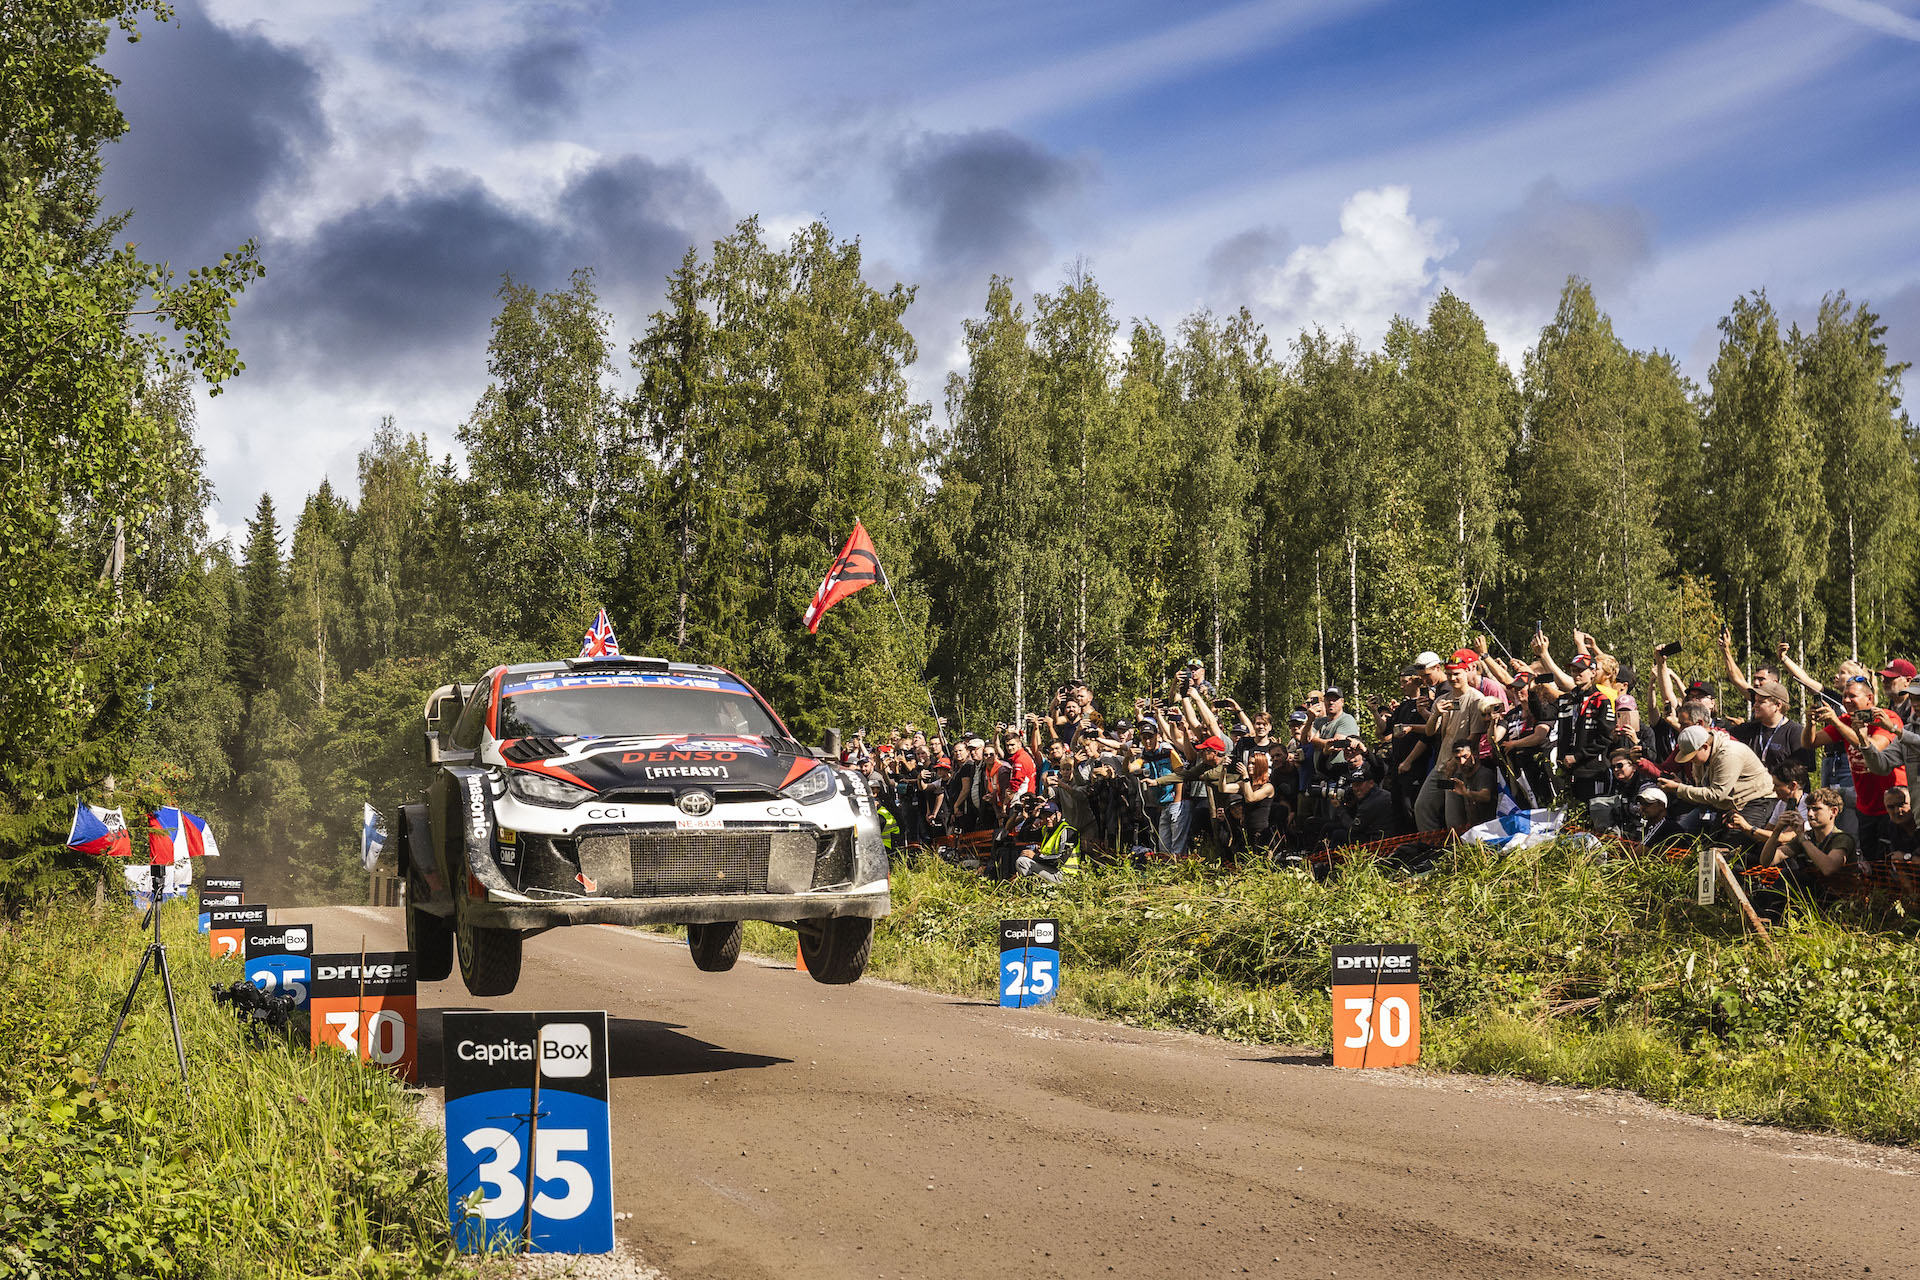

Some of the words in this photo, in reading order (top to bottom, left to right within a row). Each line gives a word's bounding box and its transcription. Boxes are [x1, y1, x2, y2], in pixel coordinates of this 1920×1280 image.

[673, 672, 720, 681] Racing
[622, 751, 738, 764] DENSO
[677, 820, 723, 828] NE-8434
[500, 850, 516, 862] OMP
[206, 879, 242, 887] Driver
[213, 910, 263, 920] Driver
[1337, 955, 1412, 969] Driver
[317, 964, 408, 980] Driver
[1005, 961, 1053, 996] 25
[251, 970, 307, 1006] 25
[1344, 996, 1410, 1049] 30
[326, 1009, 406, 1065] 30
[461, 1127, 594, 1221] 35
